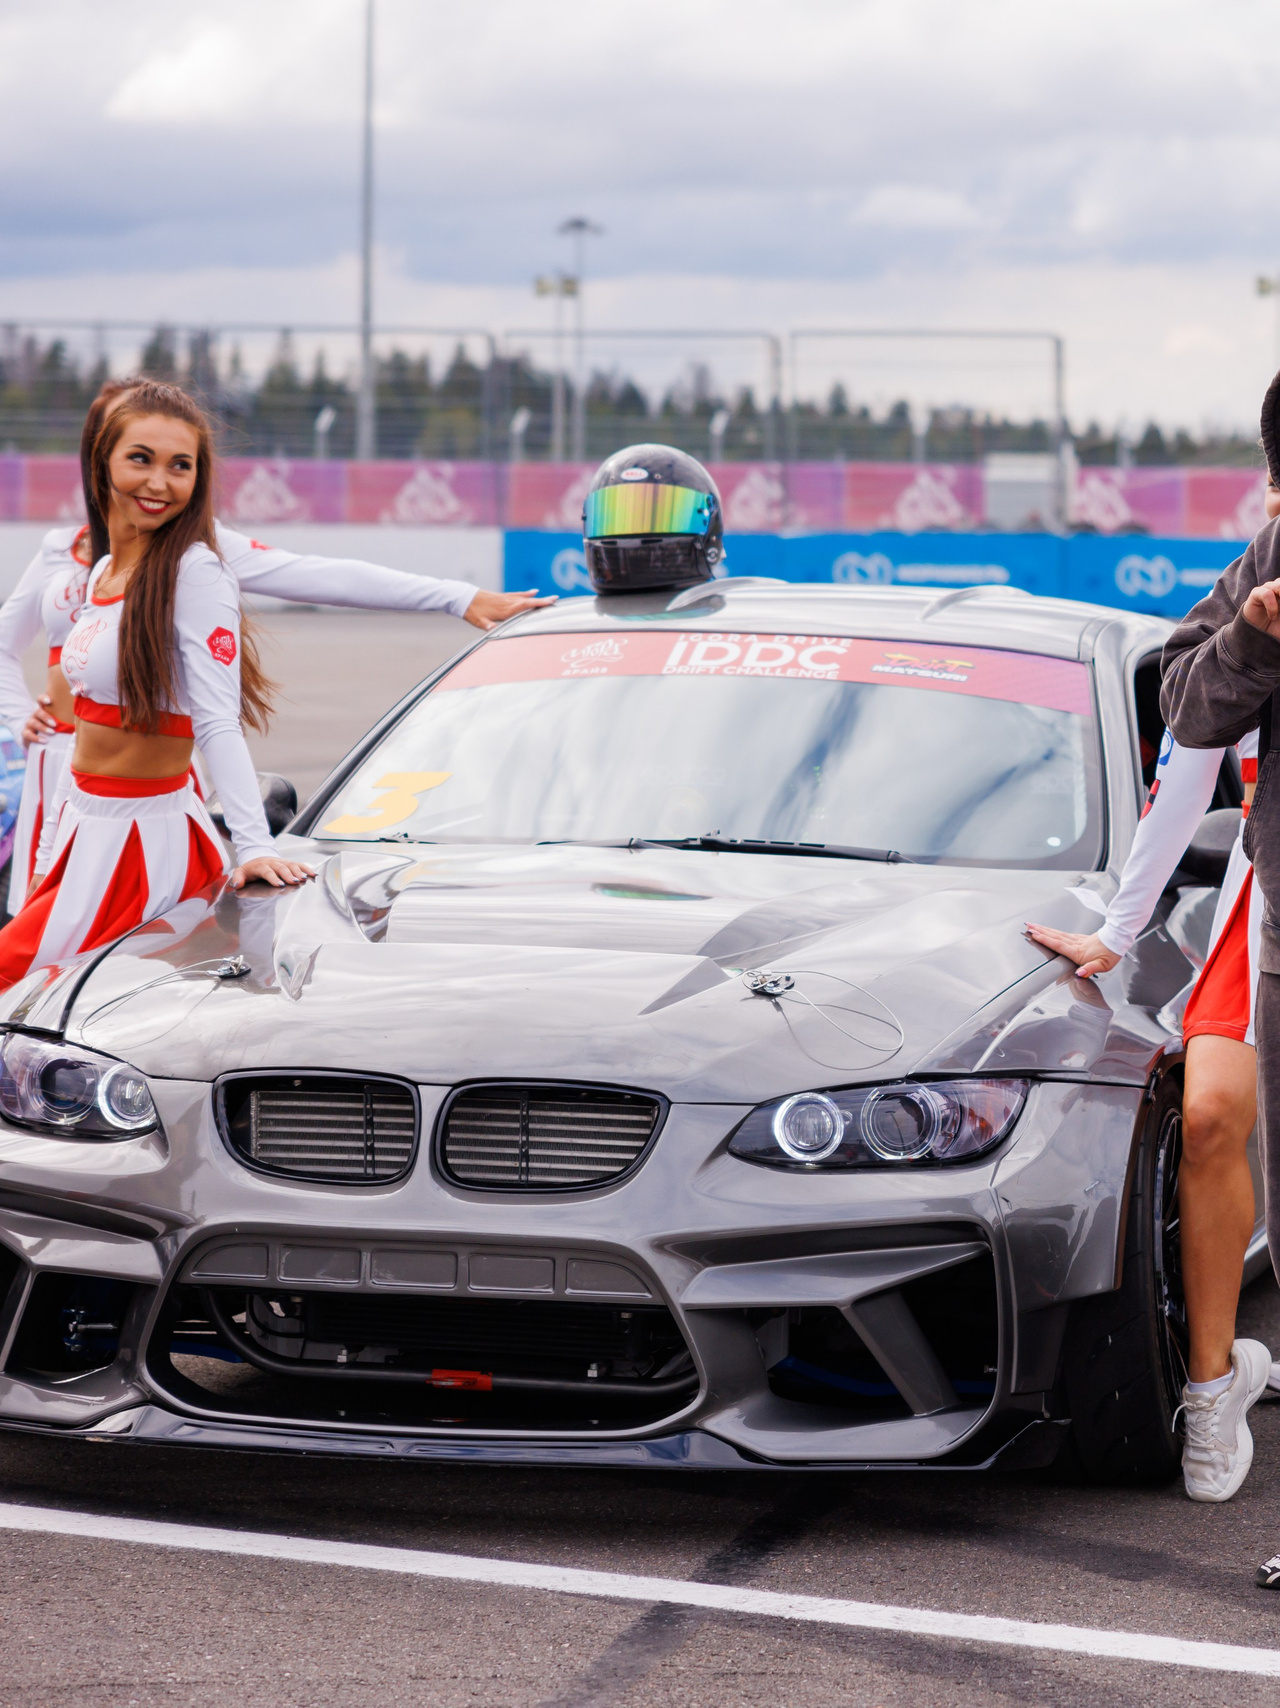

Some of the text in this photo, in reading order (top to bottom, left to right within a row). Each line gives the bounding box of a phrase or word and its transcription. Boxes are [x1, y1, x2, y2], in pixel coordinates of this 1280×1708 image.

[679, 634, 855, 647] IGORA DRIVE
[665, 640, 848, 671] IDDC
[662, 665, 840, 680] DRIFT CHALLENGE
[871, 664, 969, 682] MATSURI
[322, 771, 454, 834] 3
